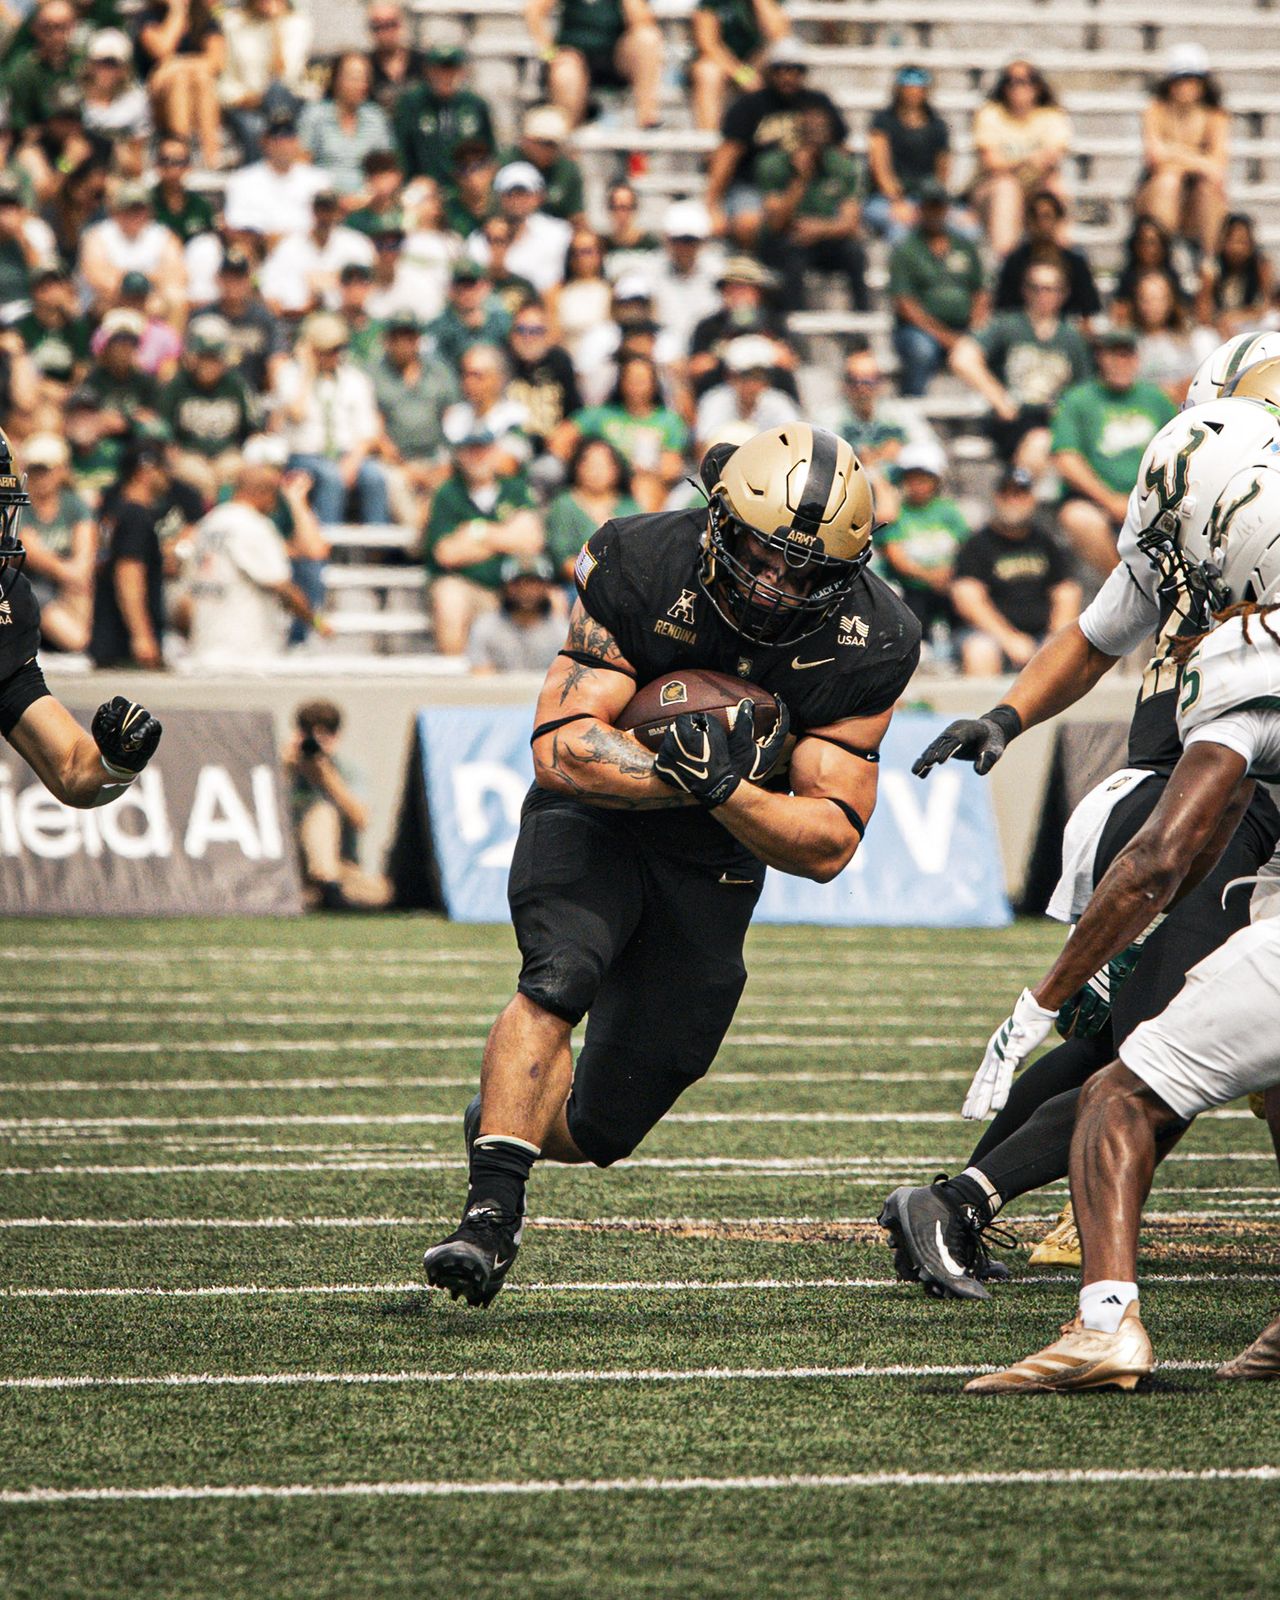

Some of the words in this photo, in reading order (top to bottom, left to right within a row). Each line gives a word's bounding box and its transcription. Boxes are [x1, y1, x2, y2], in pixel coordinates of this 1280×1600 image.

[787, 530, 816, 547] ARMY
[653, 619, 698, 645] RENDINA
[837, 634, 866, 647] USAA
